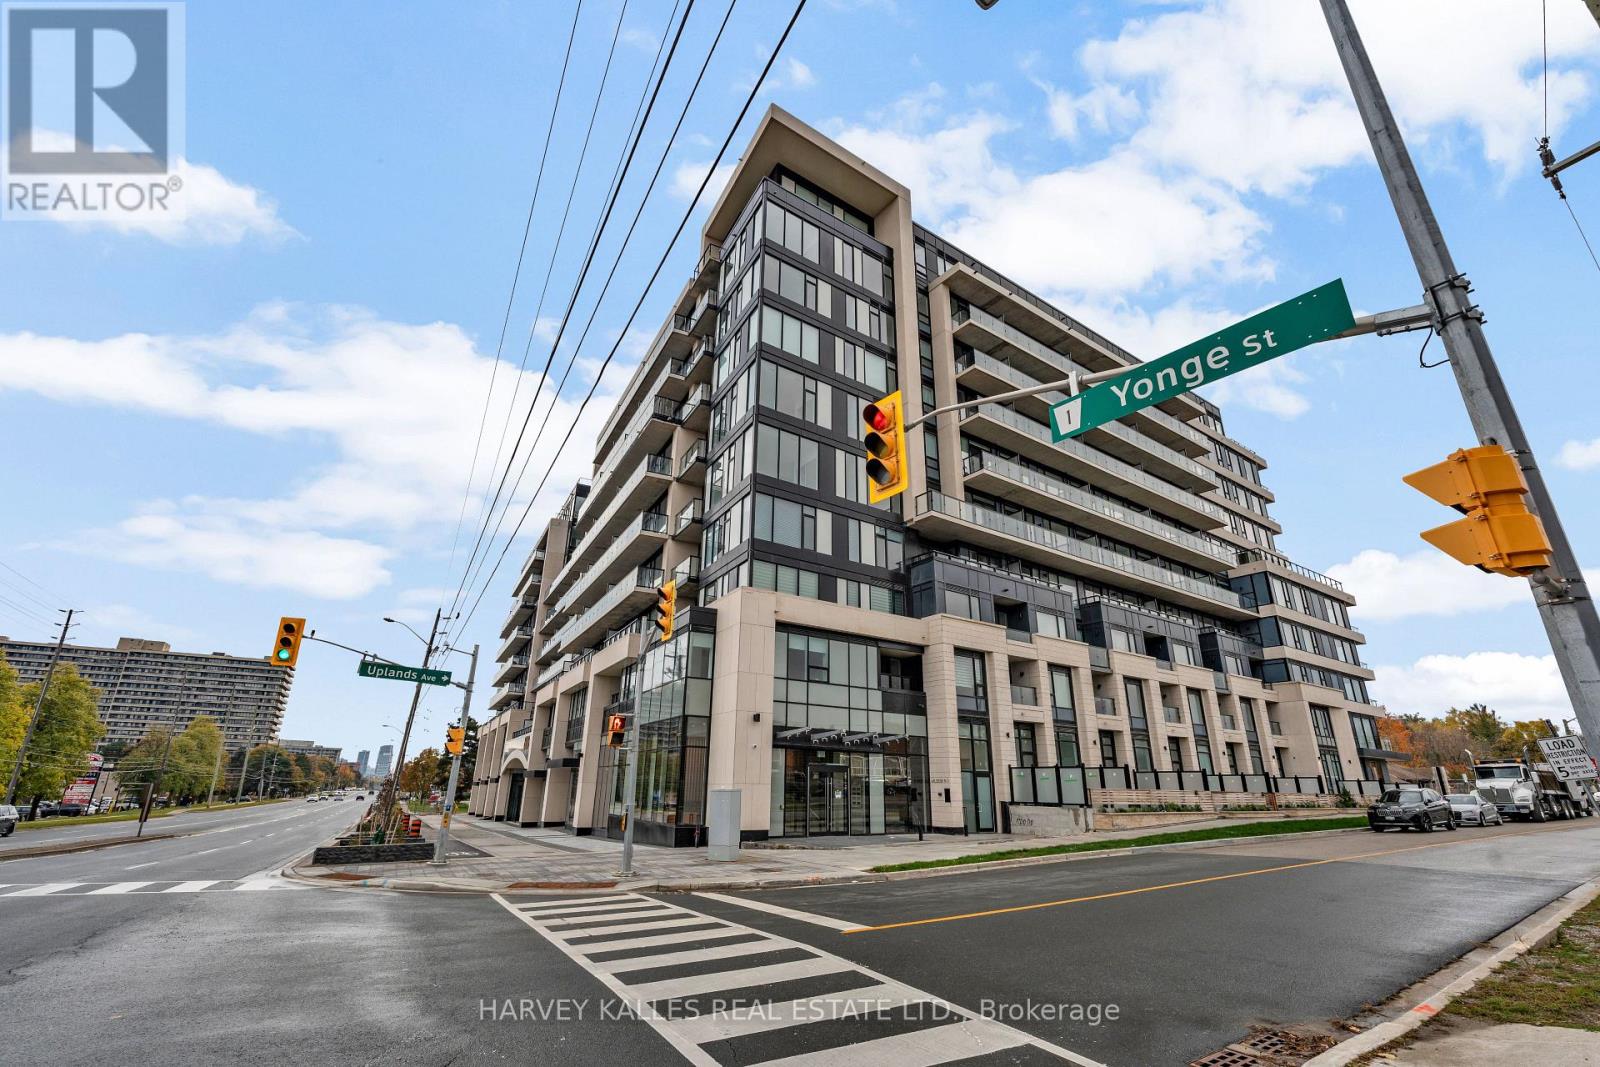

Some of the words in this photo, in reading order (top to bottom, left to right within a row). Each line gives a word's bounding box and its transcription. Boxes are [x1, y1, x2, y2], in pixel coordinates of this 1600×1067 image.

[1110, 345, 1230, 407] Yonge
[1242, 329, 1278, 356] St
[367, 665, 418, 680] Uplands
[420, 673, 437, 682] Ave
[1546, 739, 1575, 751] LOAD
[1563, 756, 1587, 765] EFFECT
[1557, 766, 1570, 778] 5
